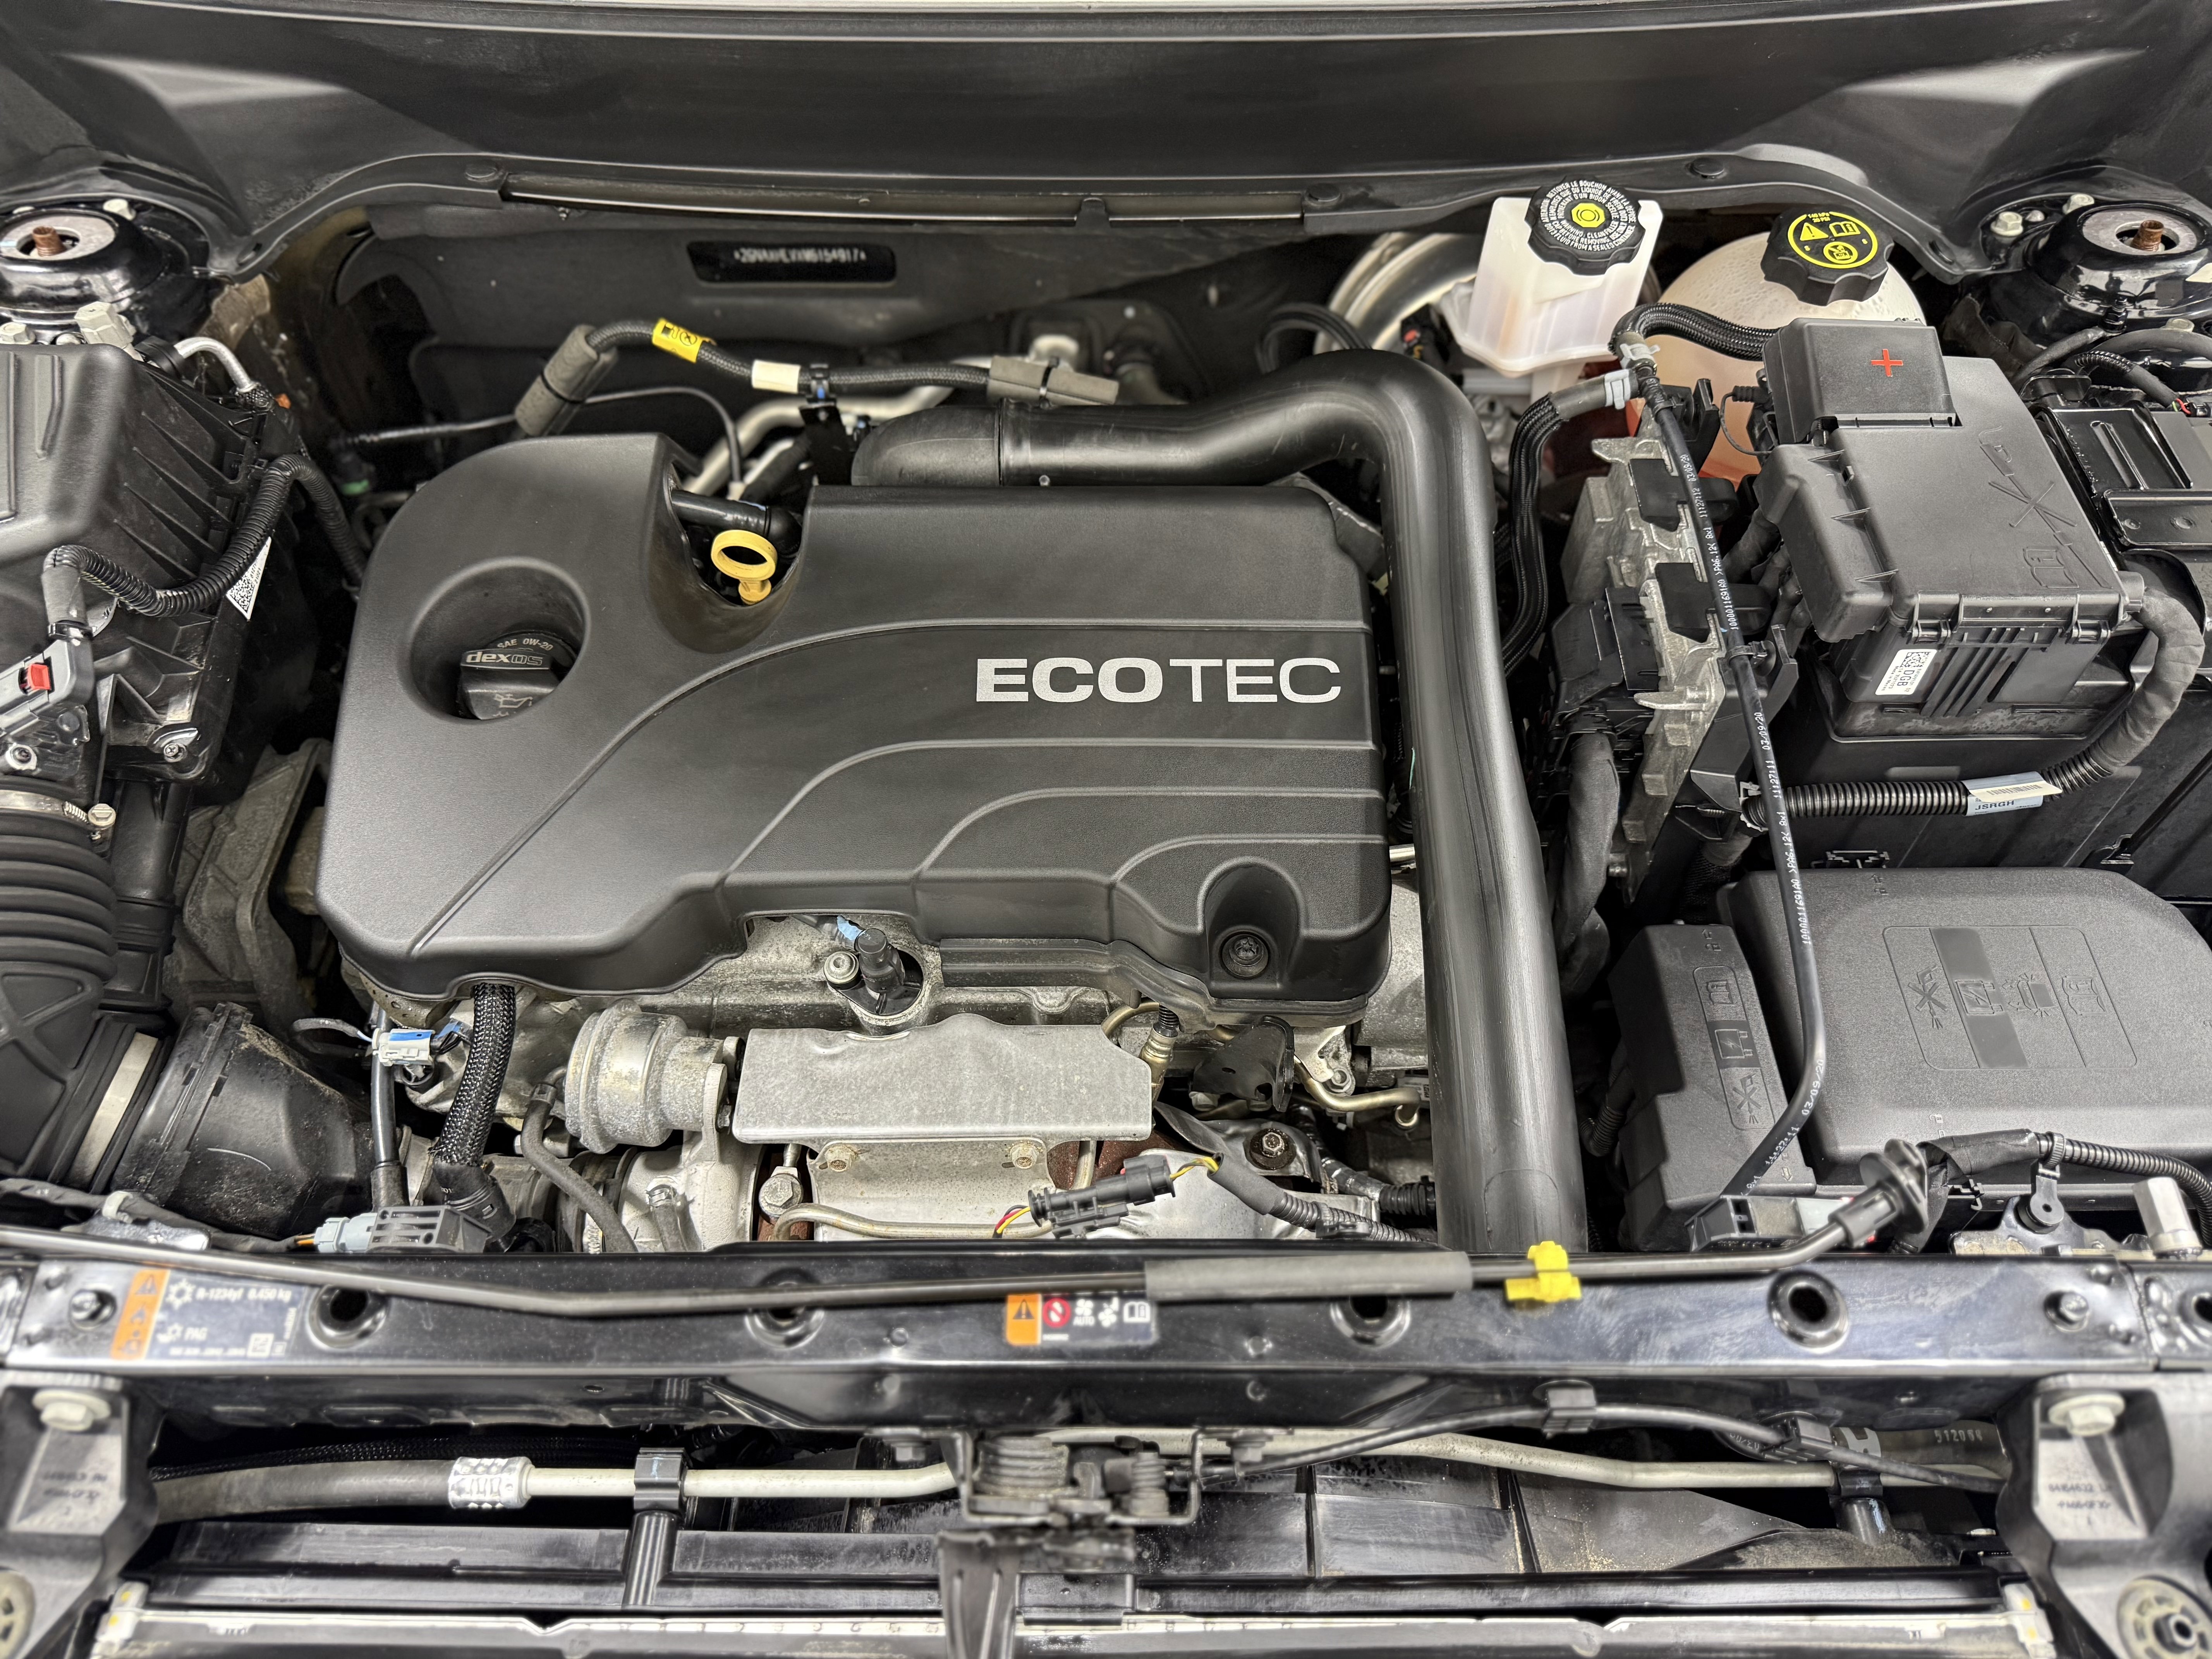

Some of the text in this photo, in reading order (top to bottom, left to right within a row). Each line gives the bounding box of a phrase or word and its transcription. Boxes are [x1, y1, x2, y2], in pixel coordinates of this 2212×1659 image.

[1579, 180, 1607, 191] BOUCHON
[1607, 187, 1624, 199] AVANT
[1581, 187, 1603, 196] LIQUIDE
[1610, 197, 1623, 210] FREIN
[1589, 193, 1608, 204] BIDON
[1552, 221, 1561, 230] CAP
[1561, 227, 1579, 242] BEFORE
[1587, 230, 1605, 238] CLEAN
[1554, 233, 1570, 245] FLUID
[1570, 242, 1588, 251] FROM
[1705, 527, 1714, 539] 8x1
[498, 638, 553, 651] SAE 0W-20
[466, 651, 543, 666] dexos
[976, 657, 1341, 703] ECOTEC
[1897, 670, 1915, 686] DGB
[1754, 712, 1771, 750] 03/09/20
[1975, 800, 2014, 810] JSRGH
[1779, 812, 1788, 826] 8x1
[277, 1289, 292, 1303] kg
[1073, 1316, 1094, 1326] AUTO
[184, 1327, 207, 1341] PAG
